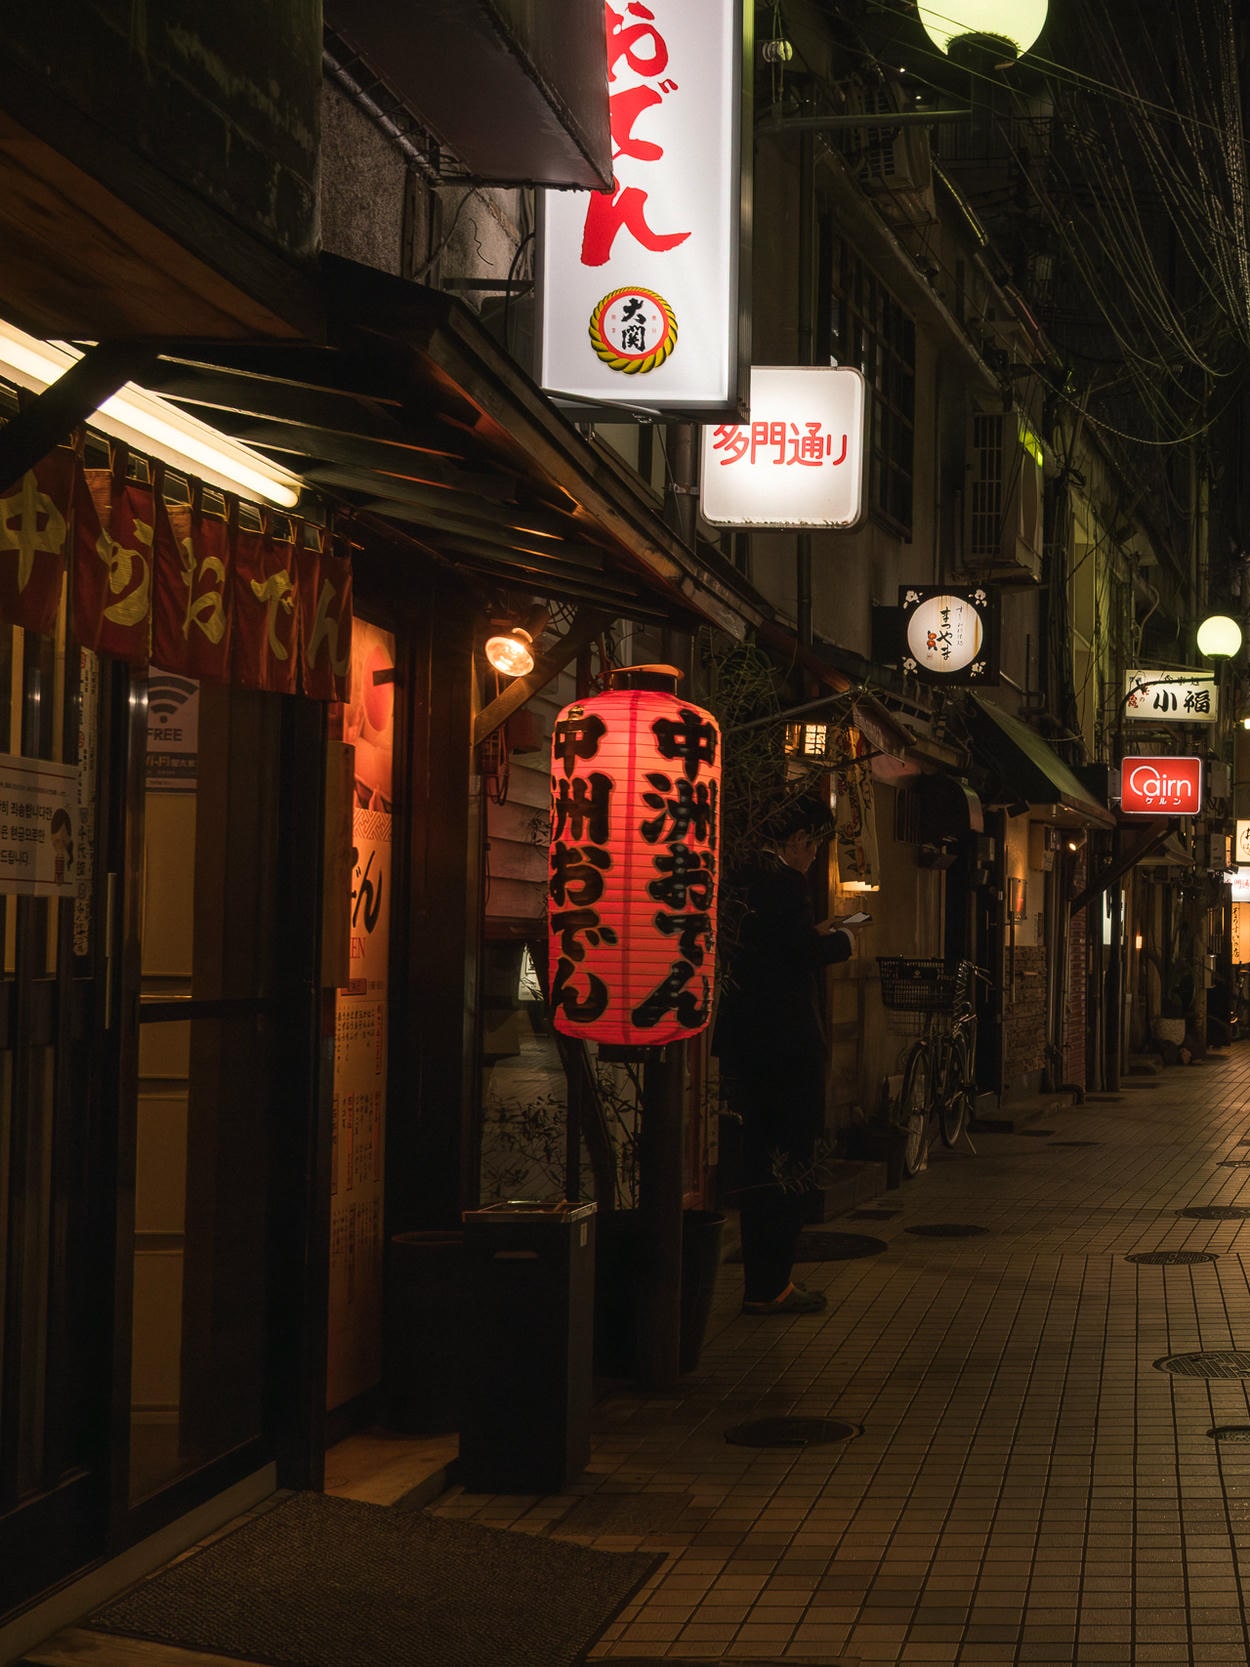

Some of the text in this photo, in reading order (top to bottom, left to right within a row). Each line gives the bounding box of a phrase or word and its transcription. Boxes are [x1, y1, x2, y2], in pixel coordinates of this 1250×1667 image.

[620, 297, 648, 353] 大関
[712, 421, 849, 467] 多門通り
[936, 606, 953, 661] まつやま
[1153, 689, 1211, 714] 小福
[1130, 765, 1192, 797] Cairn
[1145, 797, 1182, 805] ケルン
[631, 708, 718, 1030] 中洲おでん
